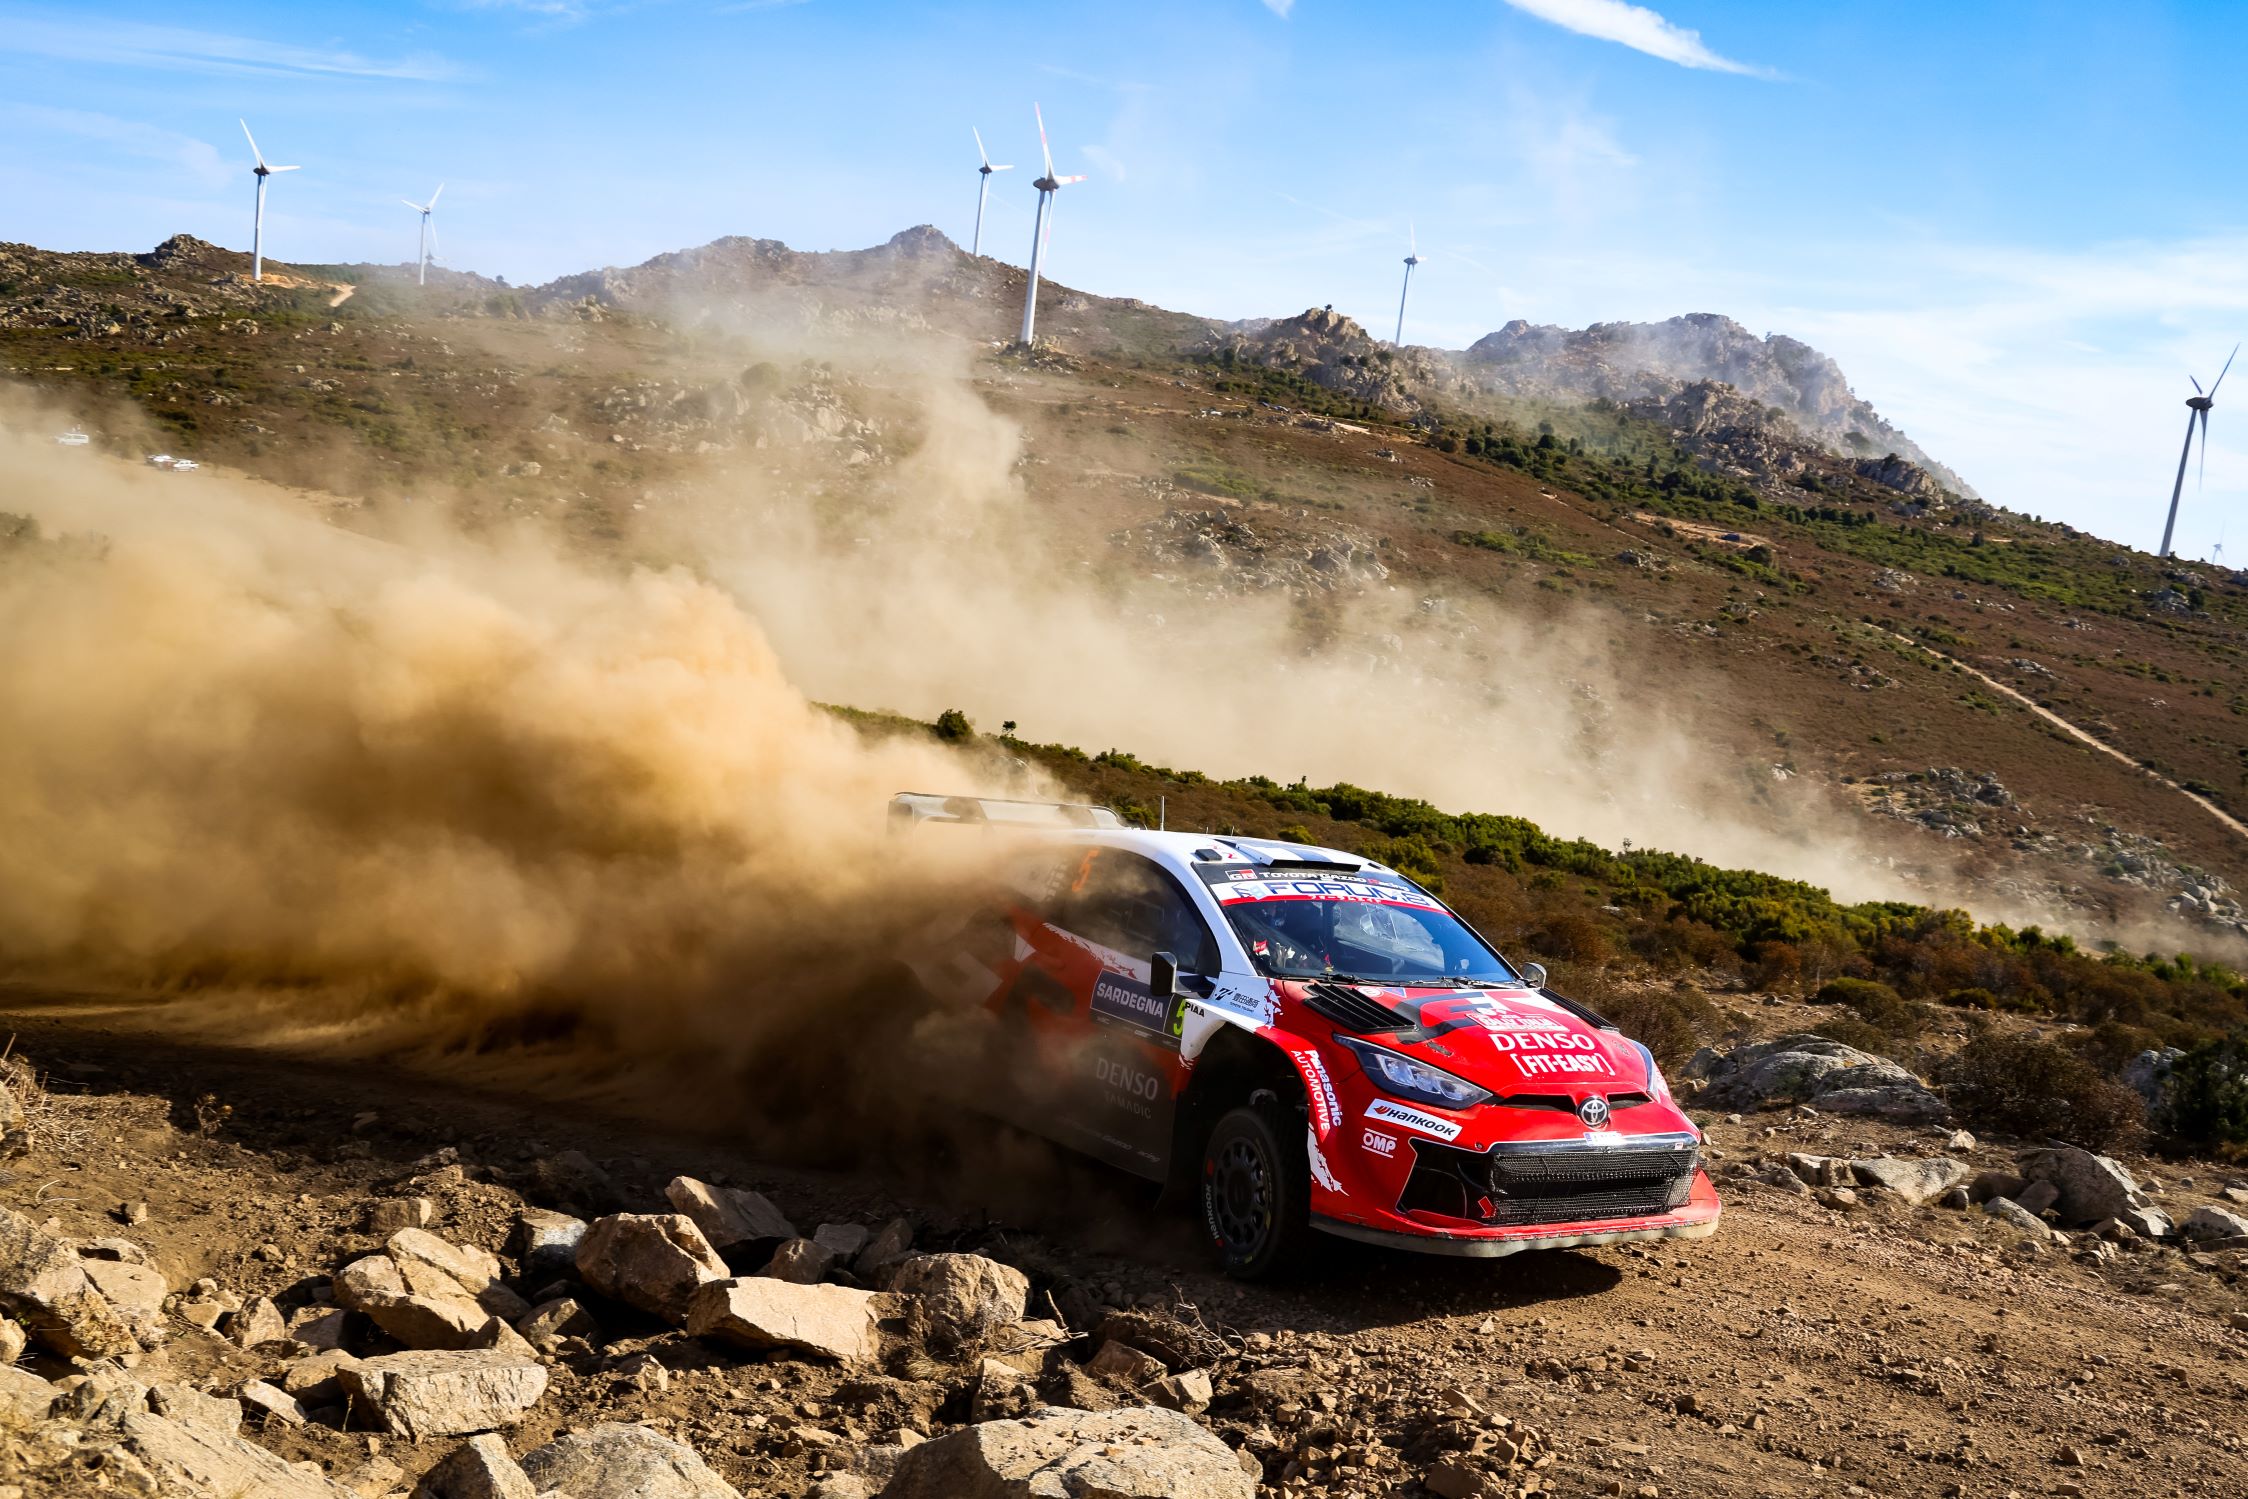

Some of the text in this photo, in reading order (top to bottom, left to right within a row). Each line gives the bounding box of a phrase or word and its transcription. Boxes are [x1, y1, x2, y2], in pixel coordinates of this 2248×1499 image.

[1317, 873, 1367, 884] GAZOO
[1265, 881, 1431, 906] FORUM8
[1096, 982, 1164, 1018] SARDEGNA
[1185, 1001, 1205, 1018] PIAA
[1173, 998, 1185, 1035] 5
[1488, 1033, 1595, 1051] DENSO
[1096, 1057, 1158, 1101] DENSO
[1292, 1050, 1331, 1130] AUTOMOTIVE
[1304, 1049, 1343, 1127] Panasonic
[1103, 1091, 1151, 1119] TAMADIC
[1363, 1132, 1396, 1153] OMP
